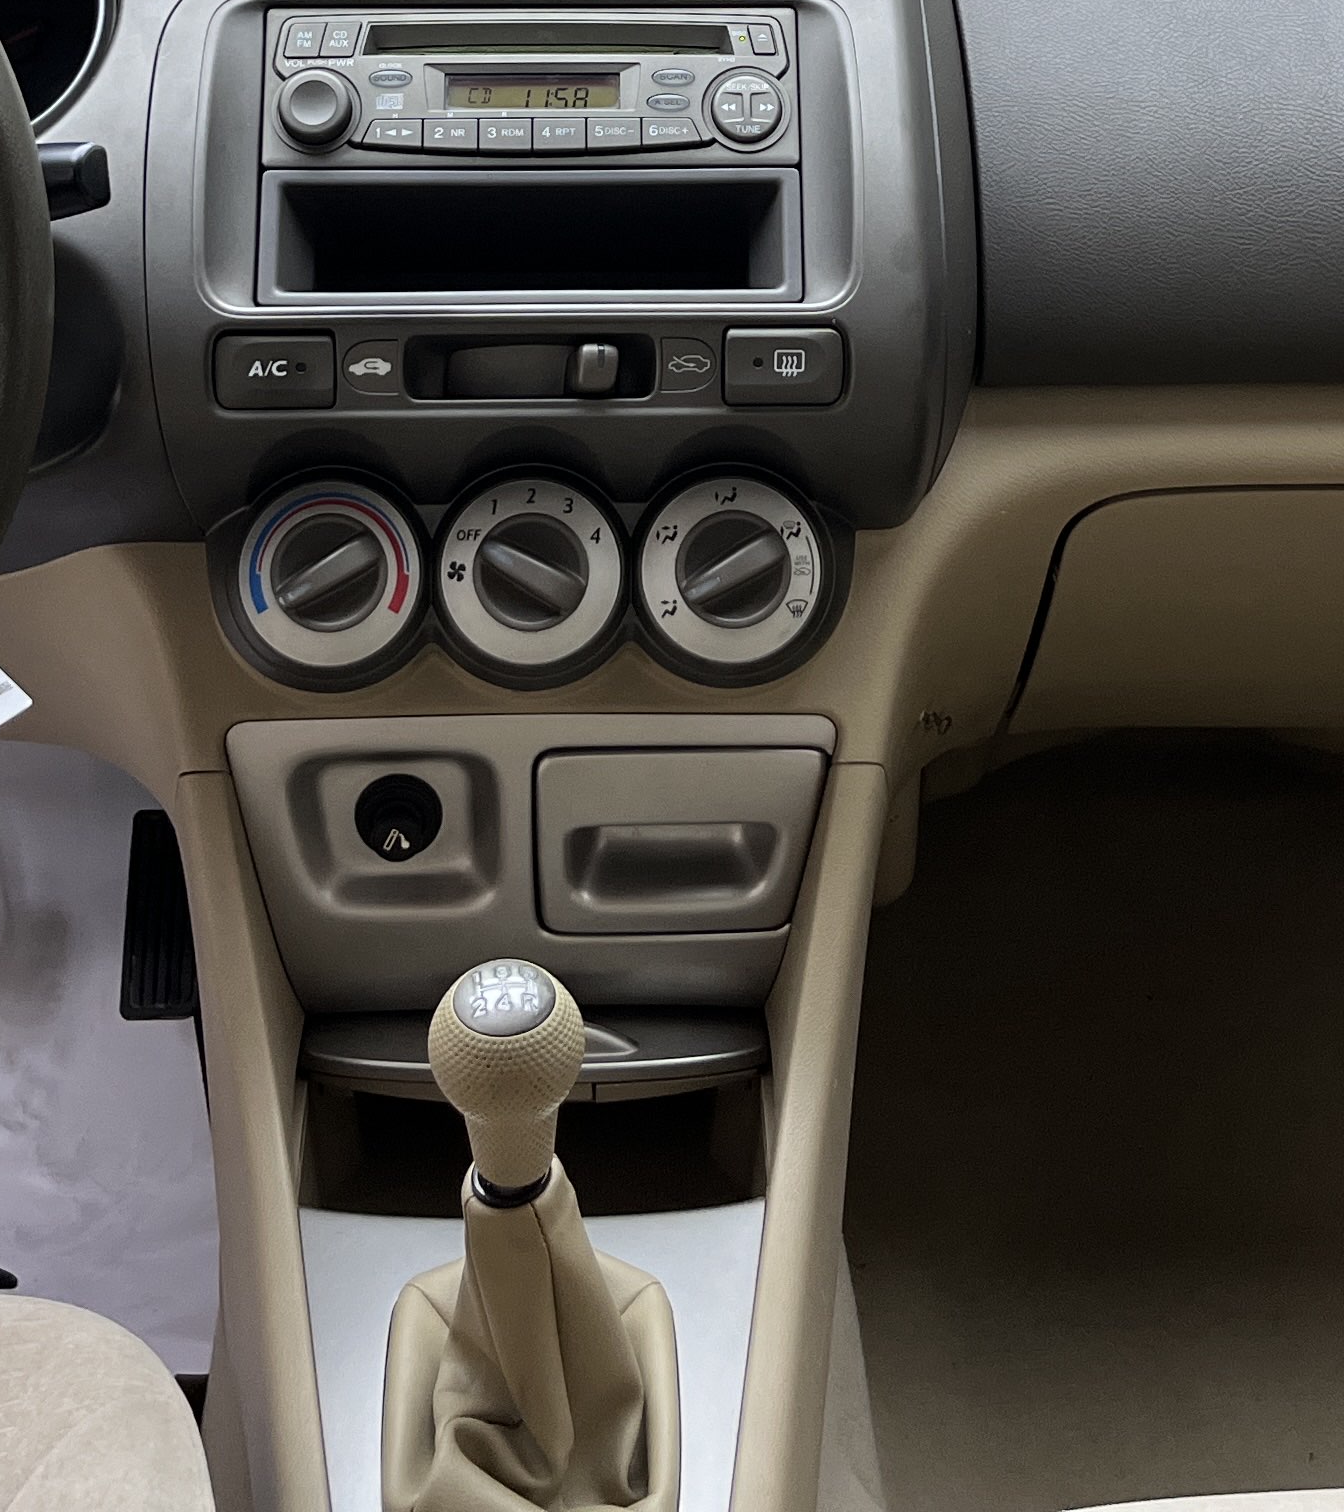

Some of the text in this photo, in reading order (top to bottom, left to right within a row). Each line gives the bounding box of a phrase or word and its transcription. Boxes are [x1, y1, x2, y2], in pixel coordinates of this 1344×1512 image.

[297, 31, 313, 39] AM
[333, 30, 348, 39] CD
[297, 40, 312, 48] FM
[329, 39, 349, 48] AUX
[284, 59, 305, 68] VOL
[328, 58, 355, 67] PWR
[659, 73, 689, 81] SCAN
[468, 88, 492, 105] CD
[375, 127, 381, 139] 1
[434, 127, 466, 139] 2 NR
[487, 127, 525, 138] 3 RDM
[541, 126, 576, 138] 4 RPT
[594, 125, 604, 137] 5
[648, 124, 658, 136] 6
[735, 124, 762, 134] TUNE
[248, 360, 288, 377] A/C
[526, 488, 537, 505] 2
[490, 498, 498, 516] 1
[562, 497, 574, 514] 3
[456, 529, 482, 542] OFF
[590, 527, 601, 545] 4
[470, 992, 539, 1019] 2 4 R
